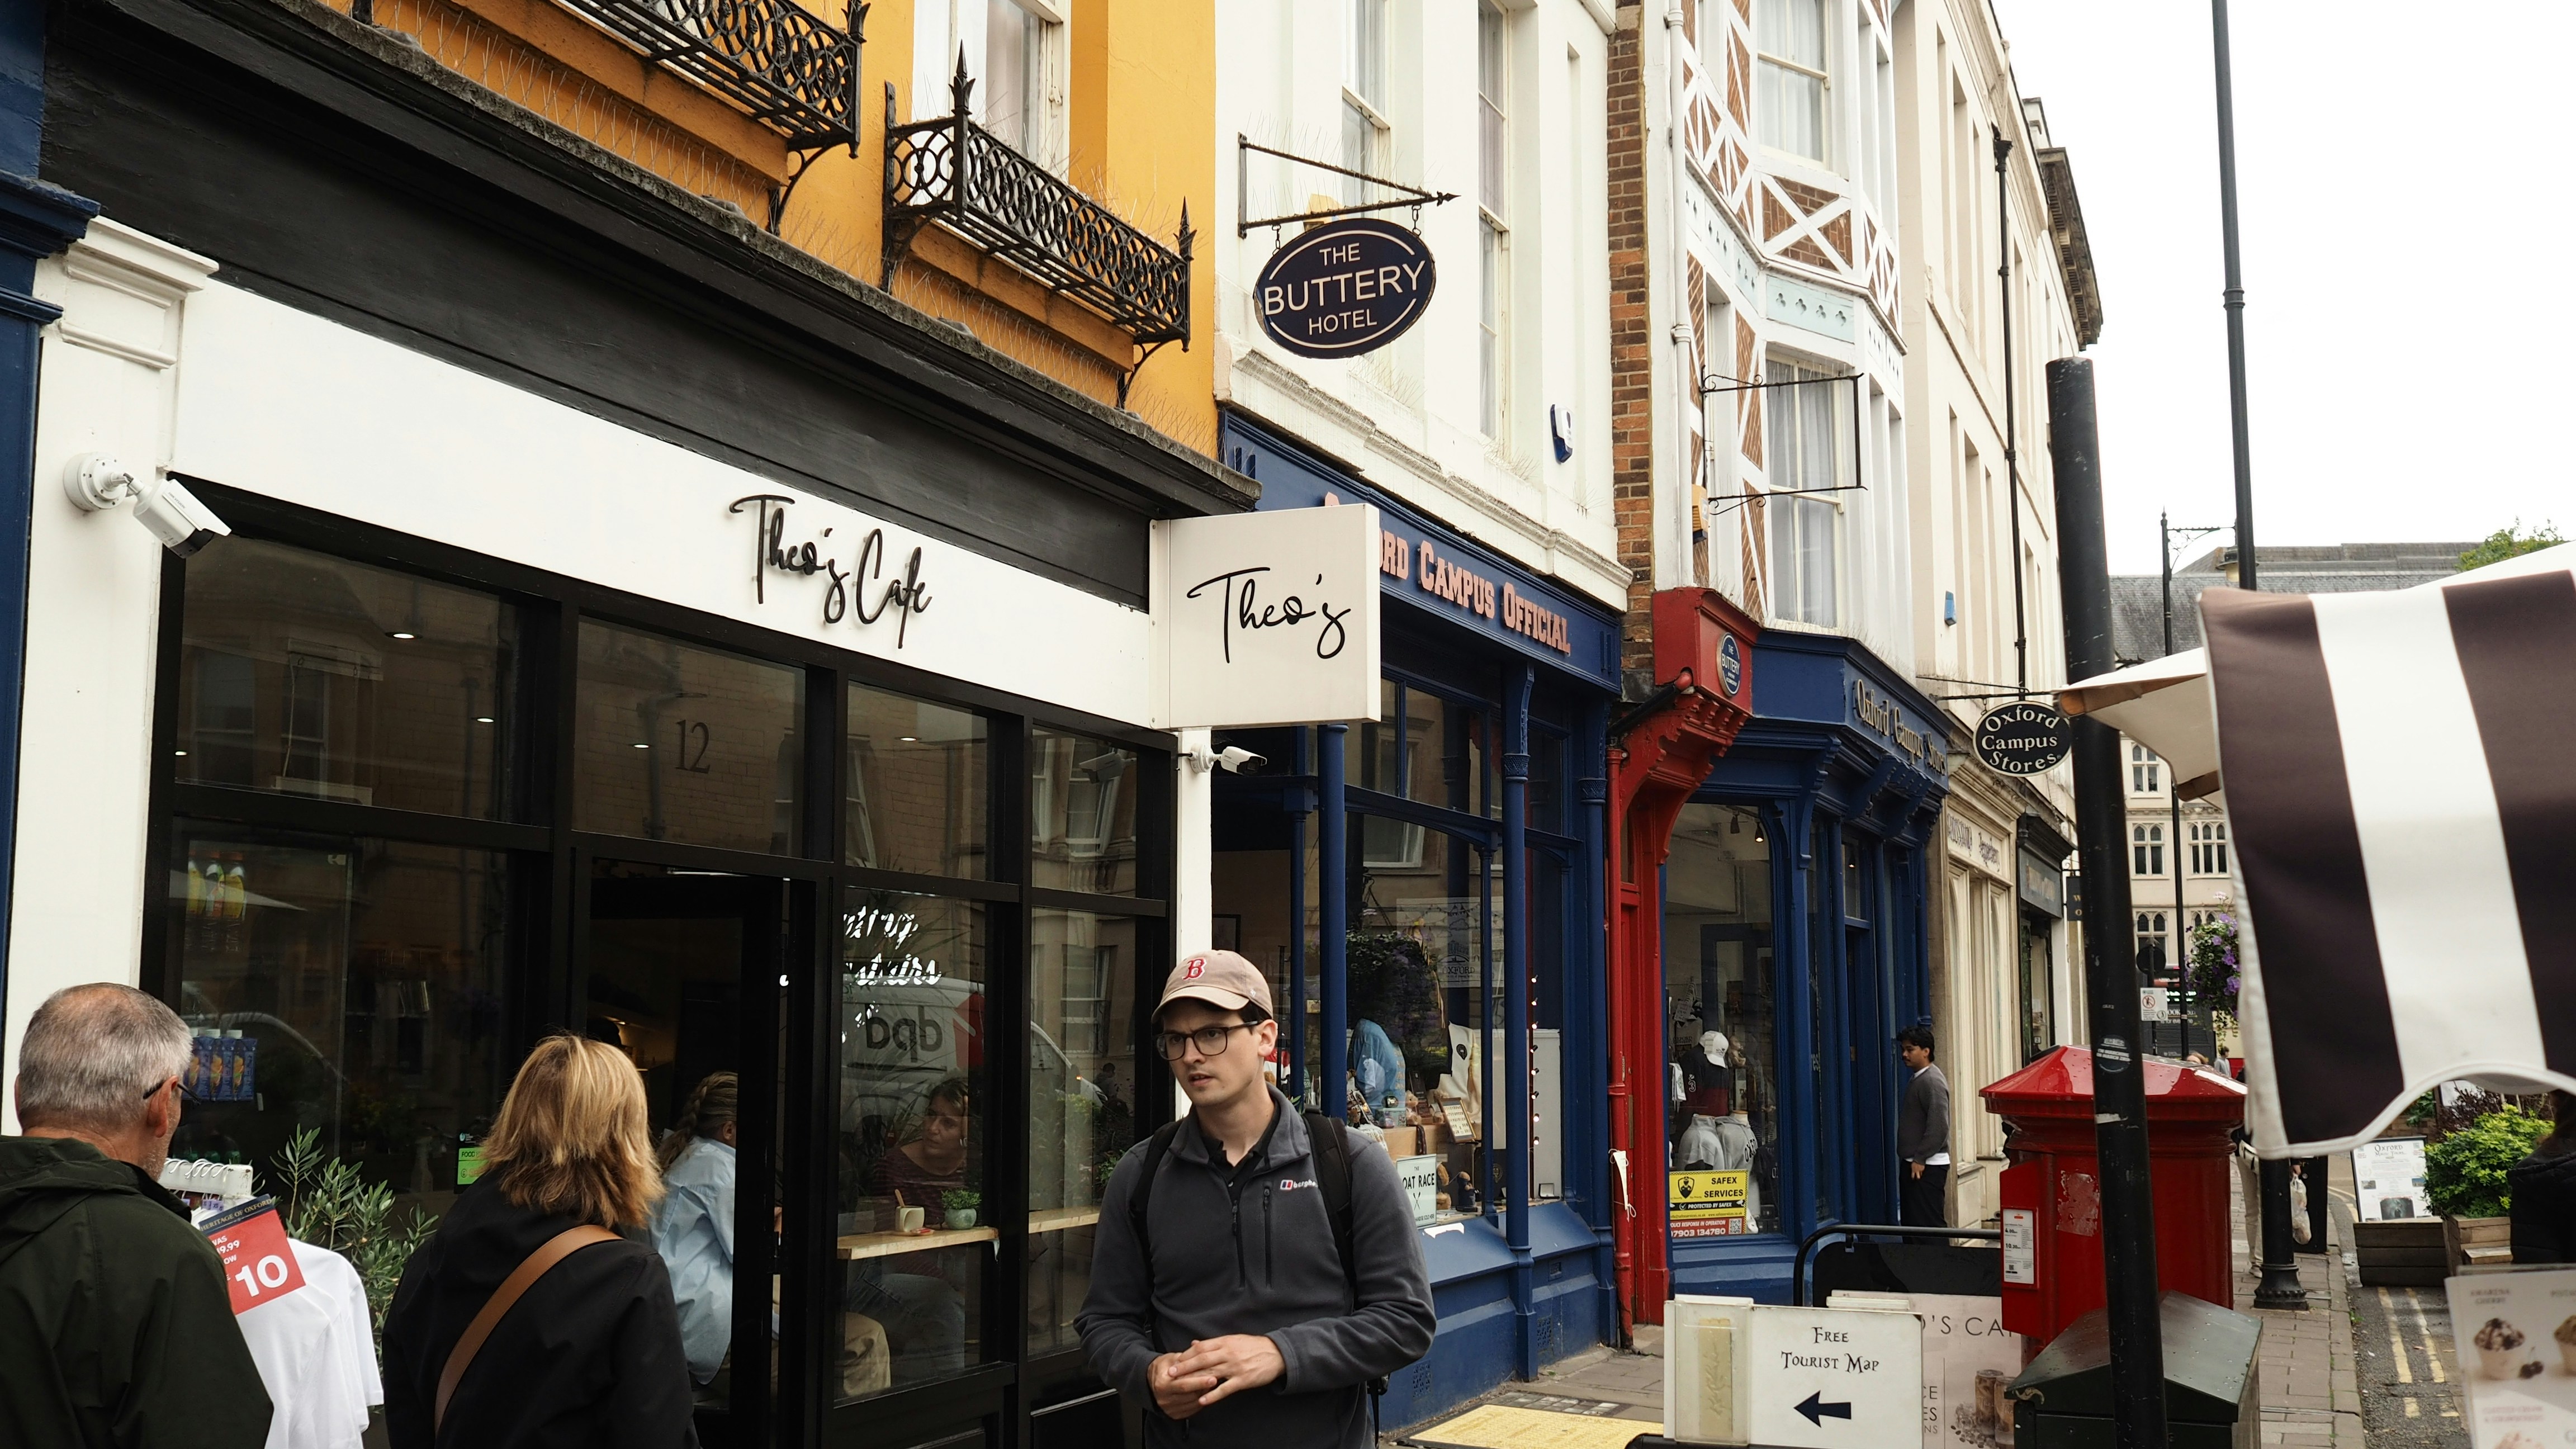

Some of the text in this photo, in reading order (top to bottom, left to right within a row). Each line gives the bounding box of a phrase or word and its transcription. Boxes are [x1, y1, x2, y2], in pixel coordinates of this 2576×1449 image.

[1319, 242, 1361, 266] THE
[1264, 260, 1426, 316] BUTTERY
[1308, 309, 1377, 335] HOTEL
[729, 494, 933, 649] Theo's Cafe
[1186, 566, 1351, 664] Theo's
[1722, 653, 1740, 675] BUTTERY
[1857, 679, 1889, 737] Oxford
[1985, 705, 2061, 732] Oxford
[675, 719, 711, 774] 12
[1981, 735, 2058, 751] Campus
[1989, 751, 2057, 773] Stores
[1182, 956, 1208, 981] B
[1402, 1172, 1435, 1190] OAT RACE
[1704, 1188, 1744, 1198] SERVICES
[1711, 1176, 1737, 1185] SAFEX
[200, 1199, 272, 1232] HERITAGE OF OXFORD
[1697, 1228, 1726, 1237] 134780
[224, 1254, 237, 1265] OW
[235, 1254, 288, 1297] 10
